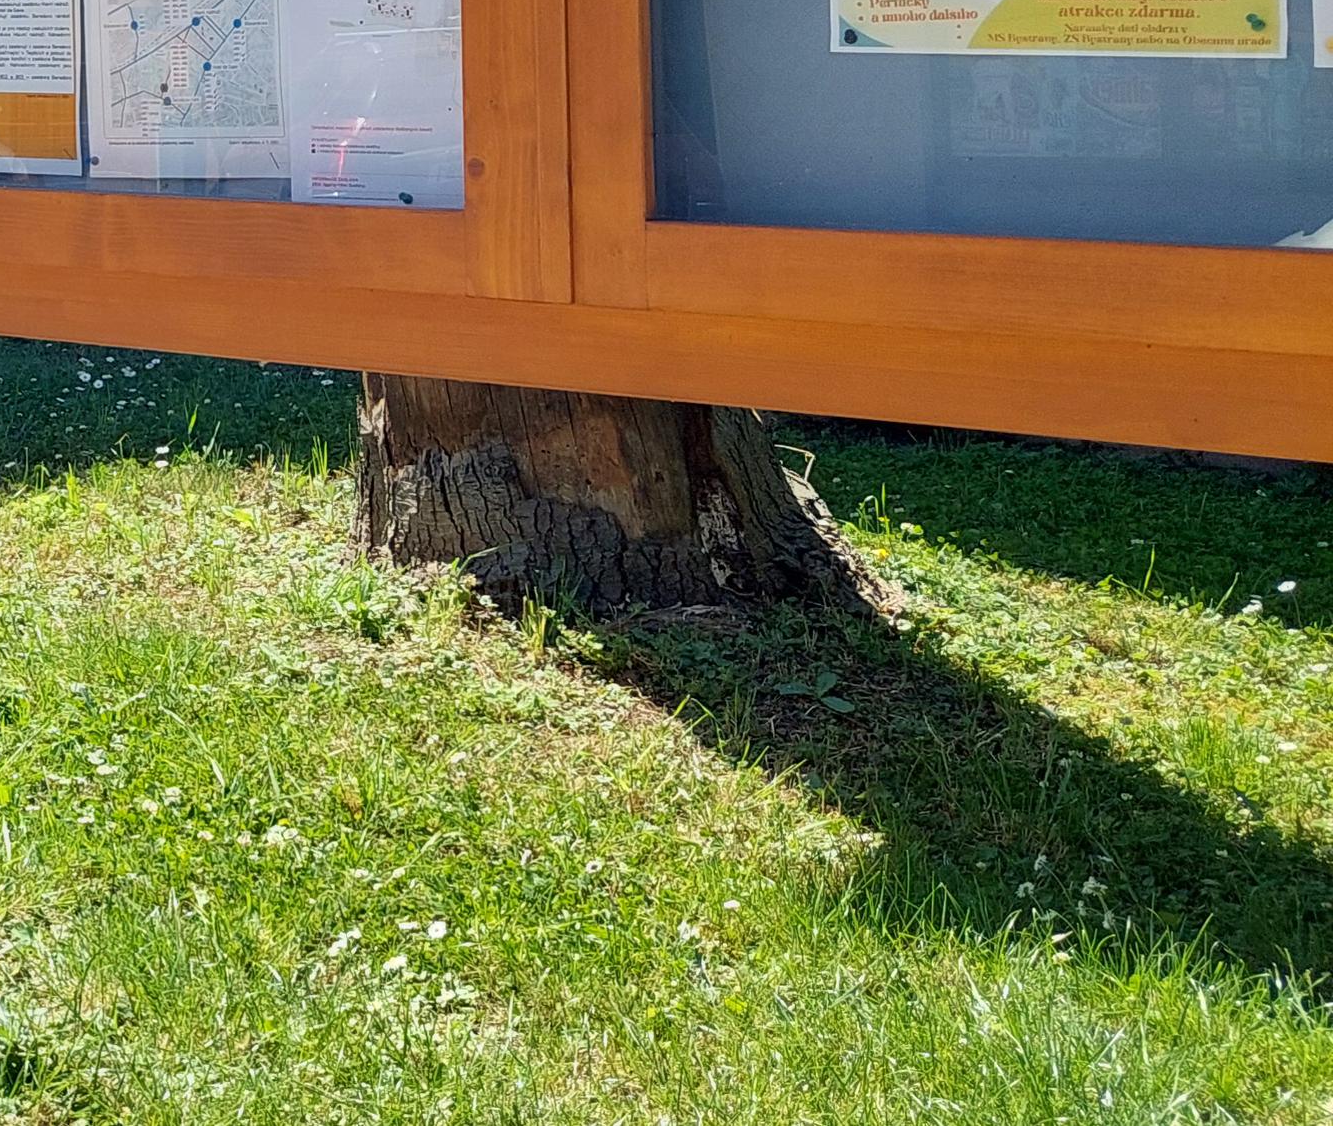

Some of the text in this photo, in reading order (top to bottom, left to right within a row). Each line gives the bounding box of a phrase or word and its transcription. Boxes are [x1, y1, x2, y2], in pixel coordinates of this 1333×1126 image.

[1058, 4, 1201, 18] atrakce zdarma.
[871, 15, 879, 23] a
